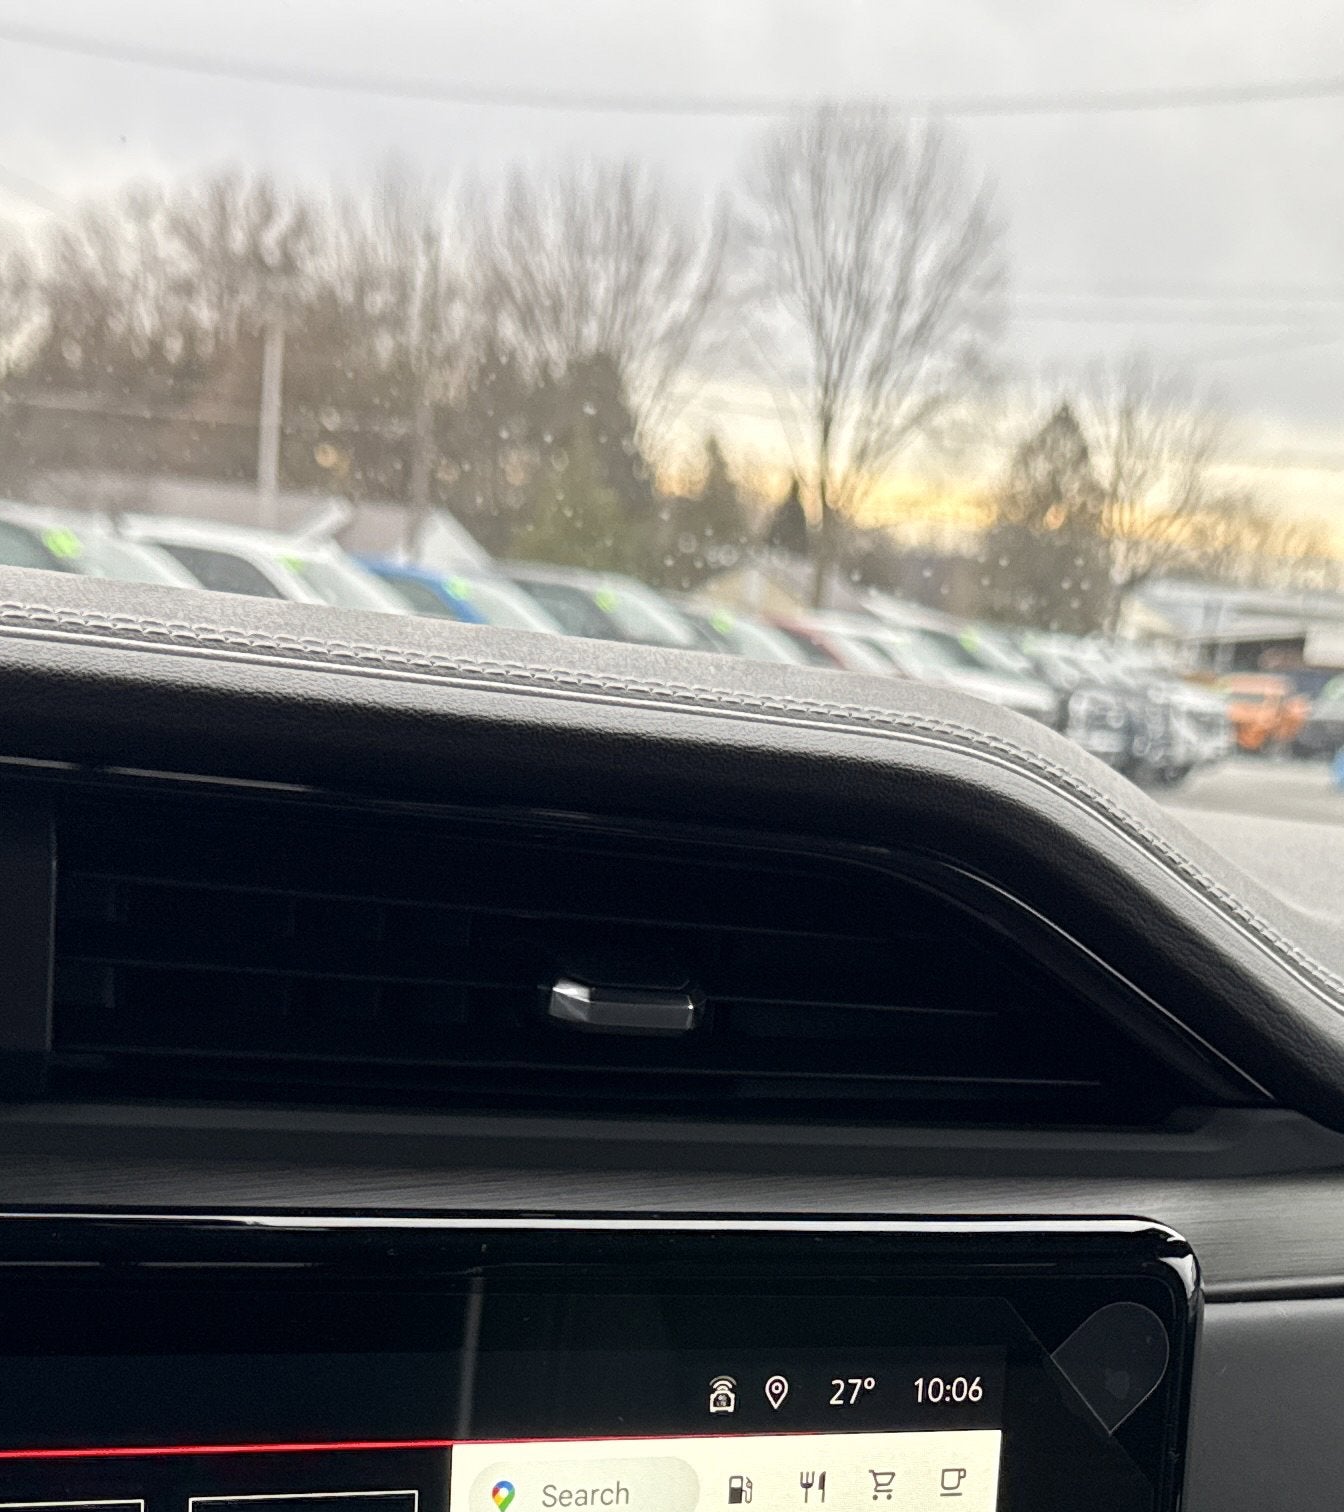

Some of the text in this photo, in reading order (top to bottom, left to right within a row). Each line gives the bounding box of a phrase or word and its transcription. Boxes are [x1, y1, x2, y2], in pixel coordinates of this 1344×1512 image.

[828, 1376, 984, 1405] 27° 10:06
[541, 1482, 631, 1509] Search
